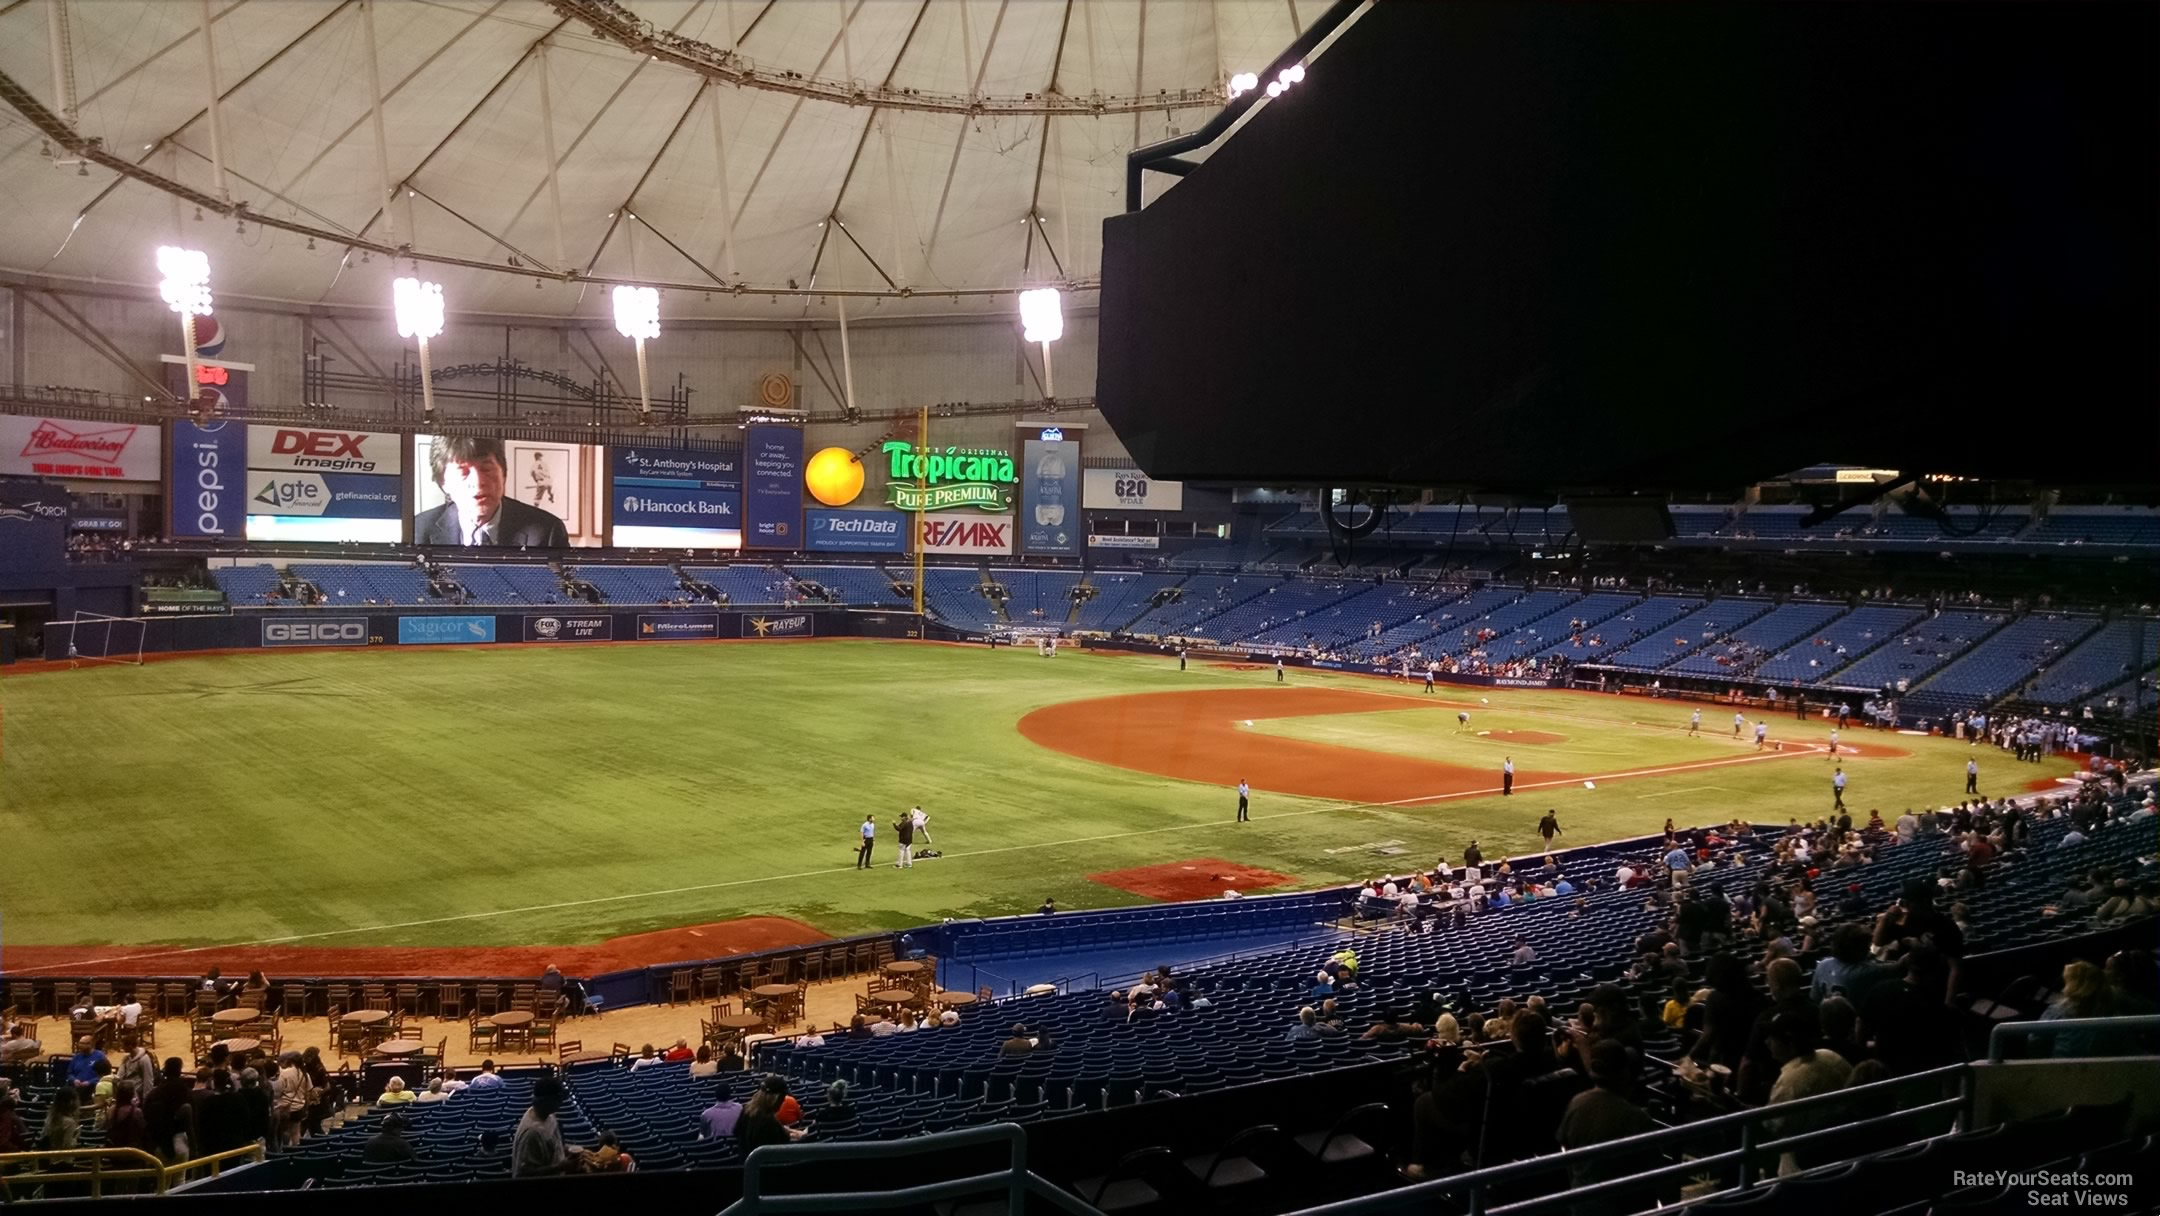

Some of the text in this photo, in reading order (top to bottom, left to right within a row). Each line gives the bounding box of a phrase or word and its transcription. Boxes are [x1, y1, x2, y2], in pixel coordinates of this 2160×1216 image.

[32, 430, 124, 452] Budweiser
[271, 429, 369, 458] DEX
[961, 448, 1009, 456] ORIGINAL
[294, 455, 376, 471] imaging
[639, 458, 733, 472] St. Anthony's Hospital
[755, 459, 782, 469] keeping
[883, 442, 1014, 483] Tropicana
[193, 443, 224, 534] pepsi
[280, 480, 318, 502] gte
[935, 487, 998, 504] PREMIUM
[1115, 479, 1148, 497] 620
[287, 500, 323, 509] financial
[335, 491, 397, 502] gtefinancial.org
[640, 499, 730, 514] Hancock Bank
[916, 520, 1006, 547] RE/MAX
[266, 623, 364, 641] GEICO
[408, 618, 464, 637] Sagicor
[566, 620, 602, 628] STREAM
[575, 628, 593, 636] LIVE
[657, 622, 714, 630] MicroLumen
[369, 635, 383, 644] 370
